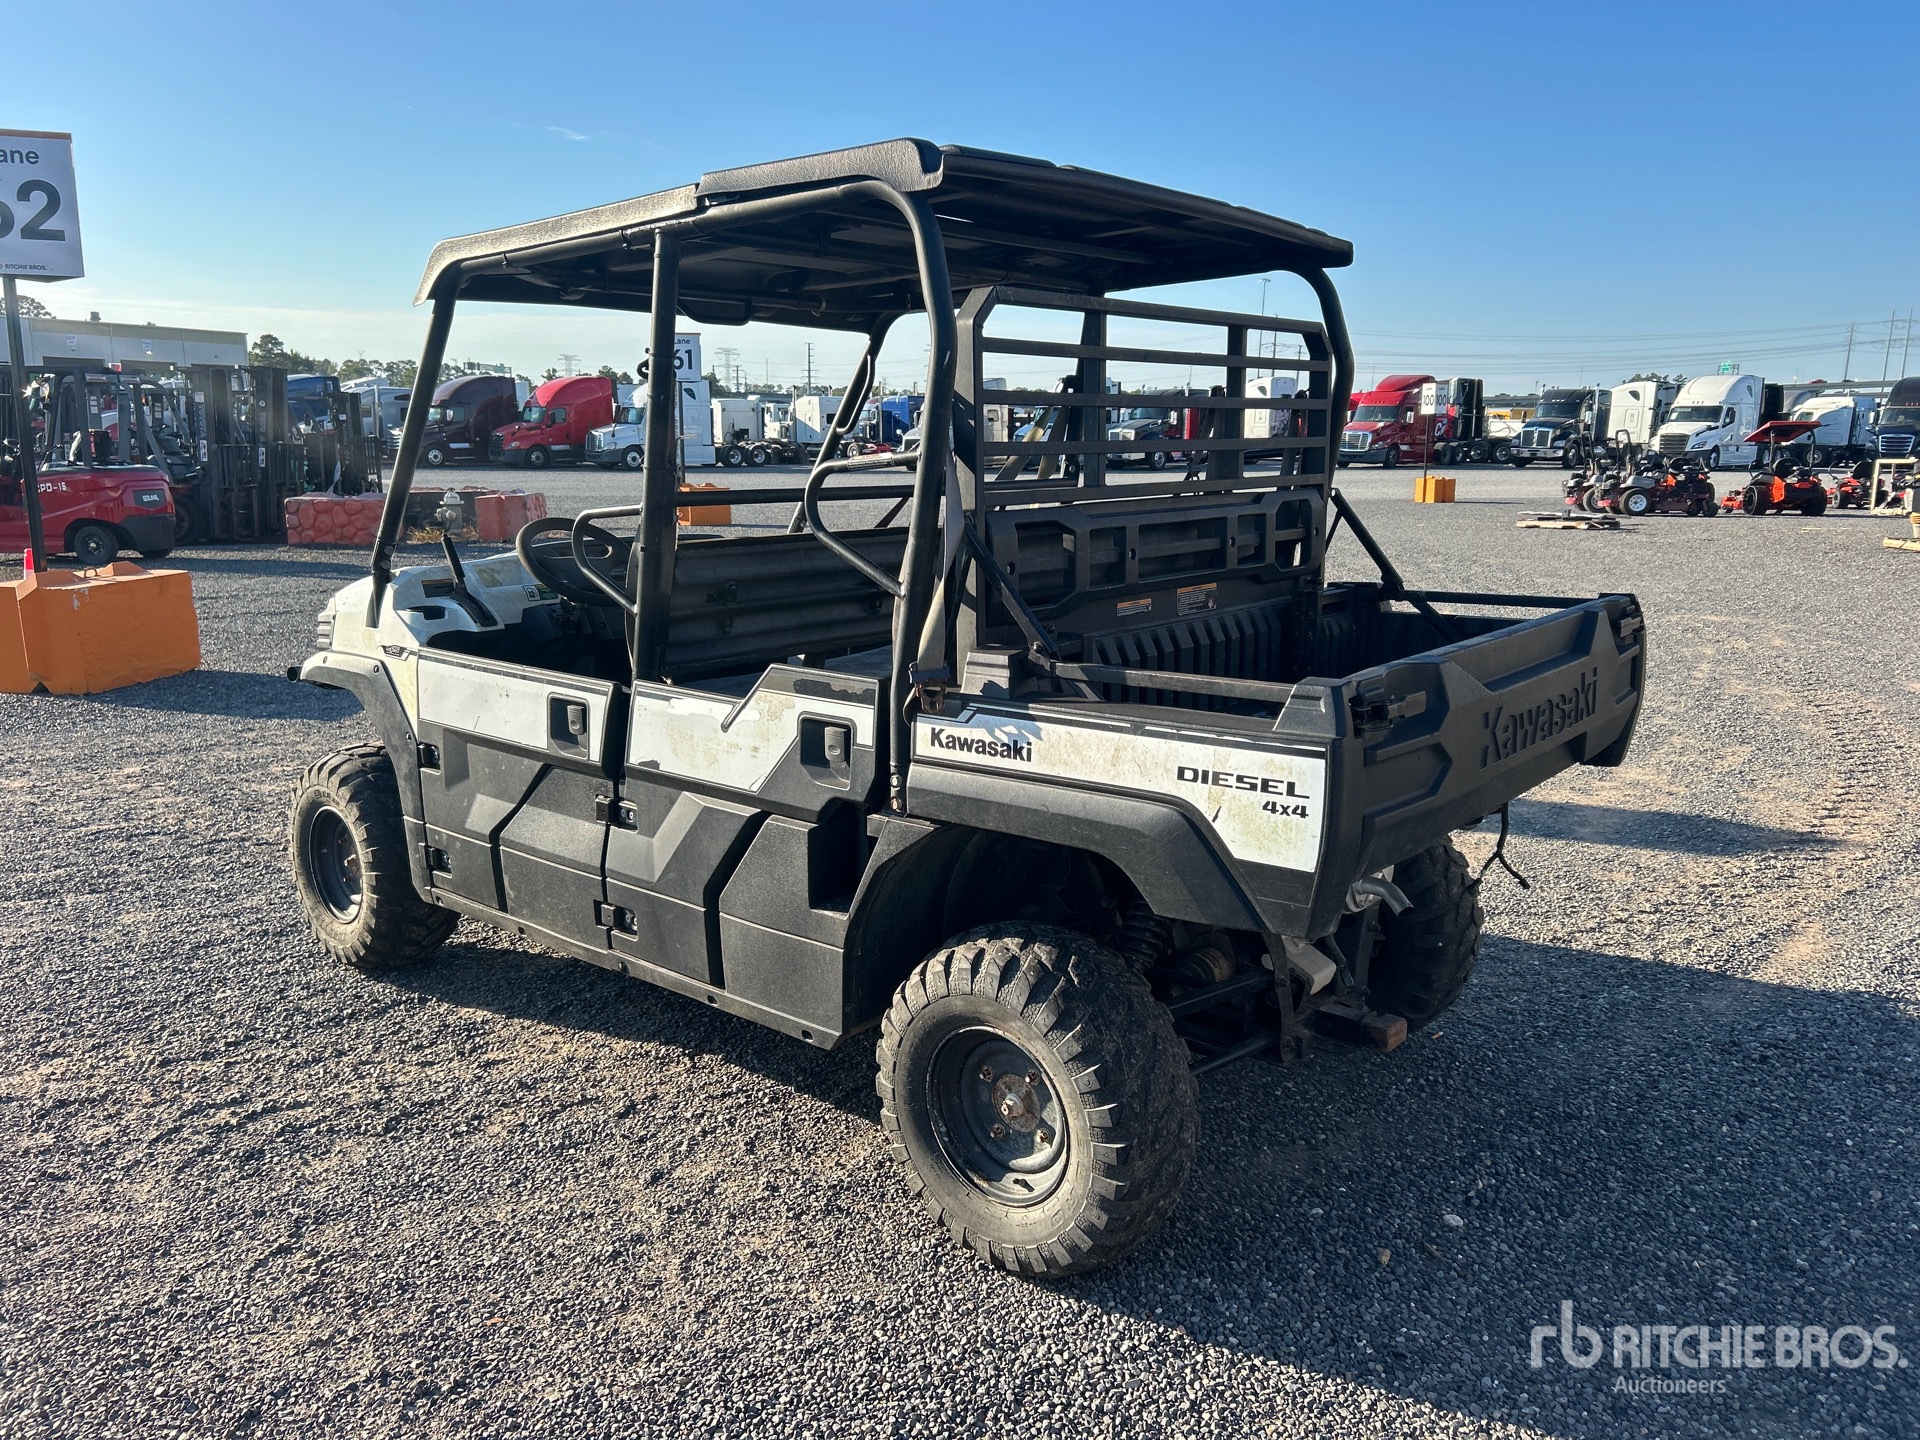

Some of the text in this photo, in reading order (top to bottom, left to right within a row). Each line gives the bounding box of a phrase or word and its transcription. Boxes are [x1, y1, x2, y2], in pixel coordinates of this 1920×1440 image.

[0, 149, 40, 165] ane
[674, 348, 693, 370] 61
[1423, 395, 1435, 406] 100
[1436, 395, 1447, 406] 100
[1479, 666, 1599, 770] Kawasaki
[930, 727, 1033, 763] Kawasaki
[1176, 765, 1311, 800] DIESEL
[1261, 800, 1310, 819] 4x4
